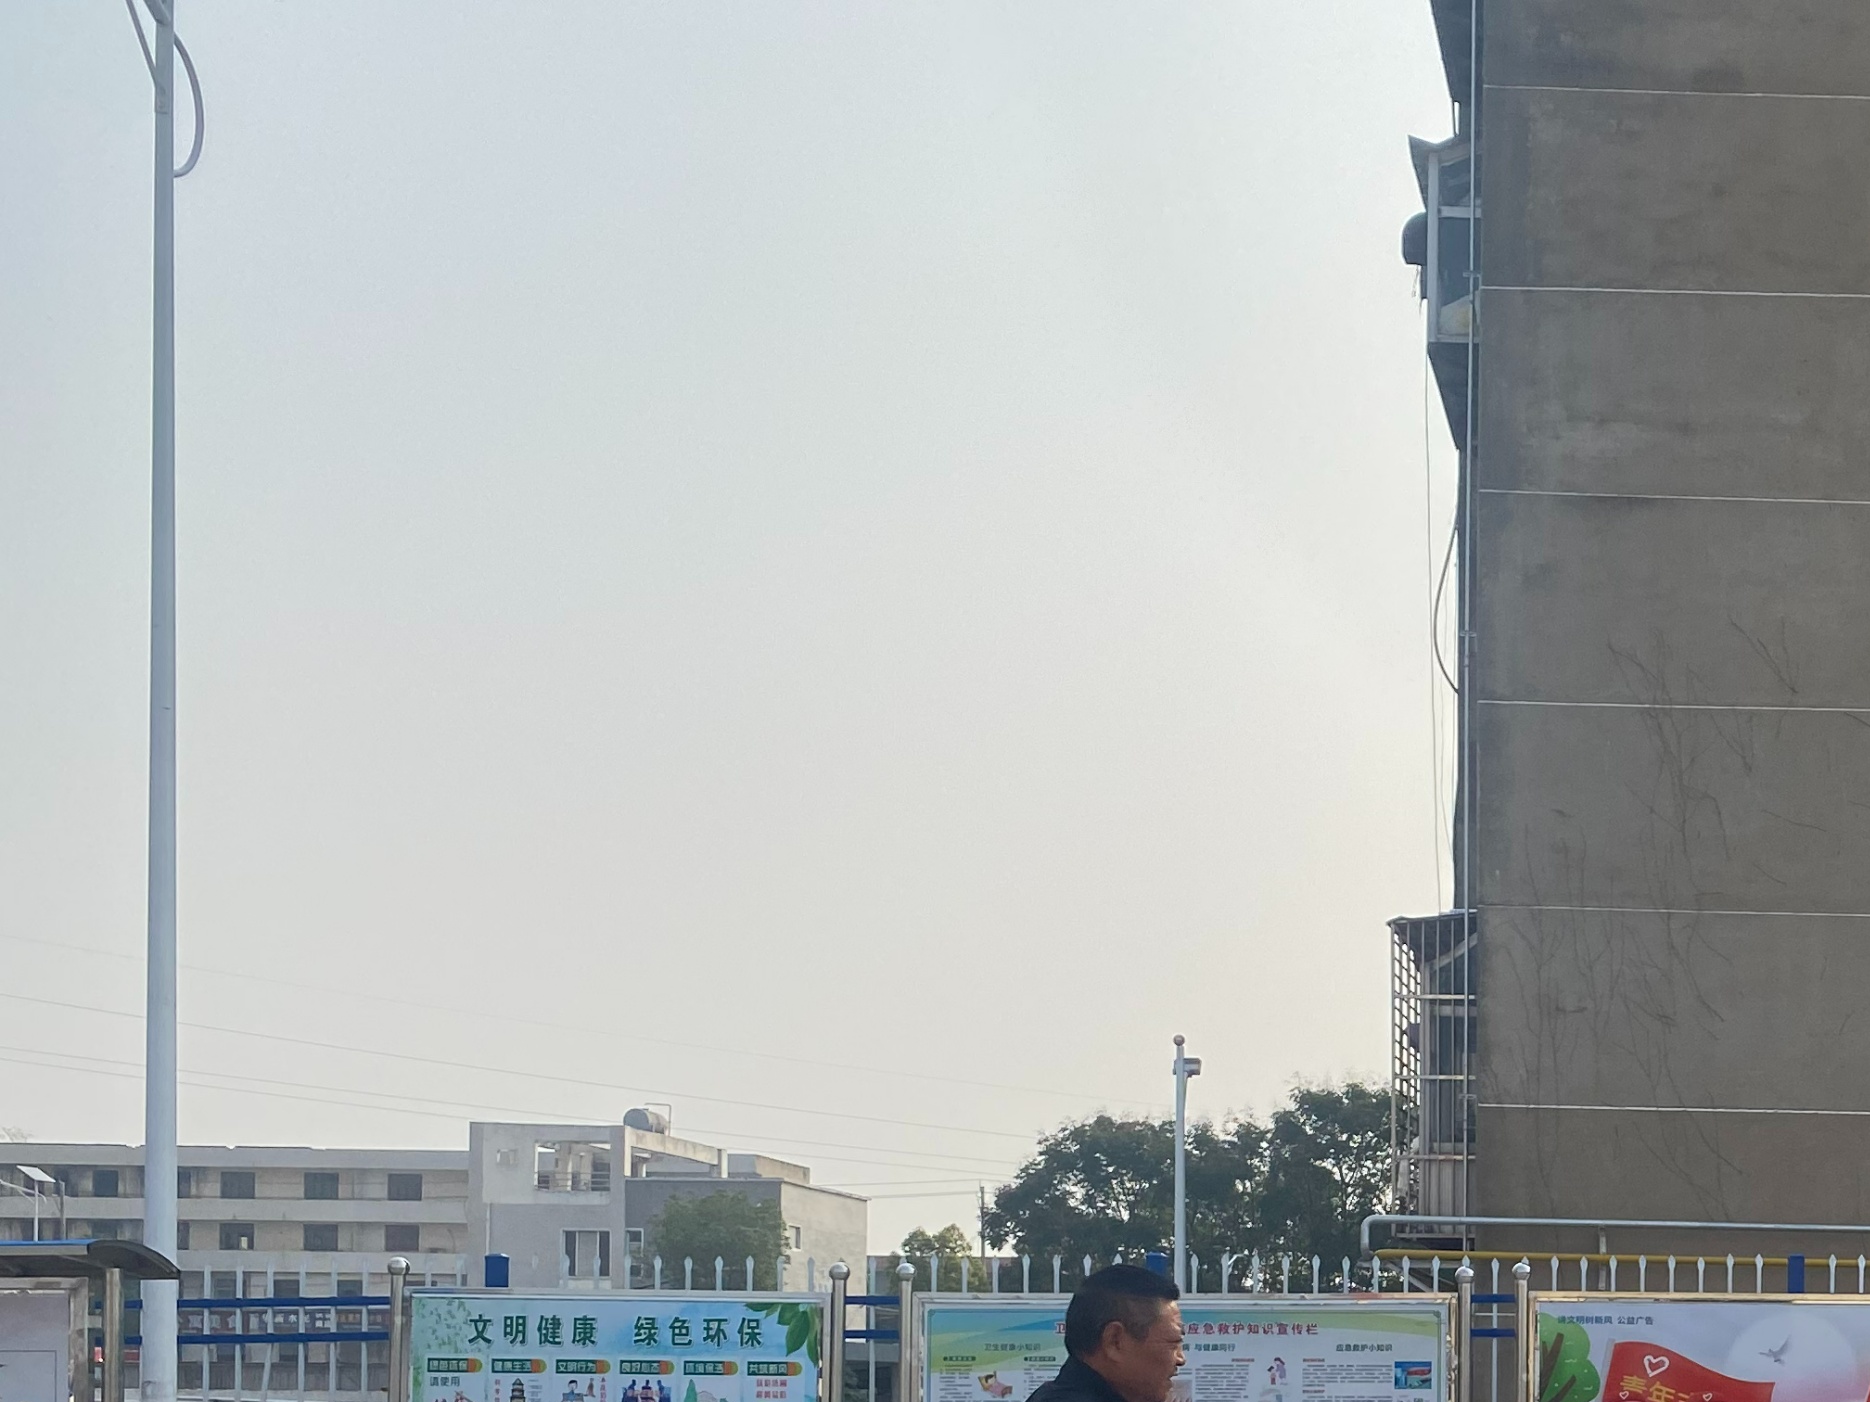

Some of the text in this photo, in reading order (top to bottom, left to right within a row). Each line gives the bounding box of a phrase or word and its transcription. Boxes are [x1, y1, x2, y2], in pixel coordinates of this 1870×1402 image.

[468, 1314, 763, 1348] 文明健康 绿色环保
[1617, 1316, 1654, 1325] 公益广告
